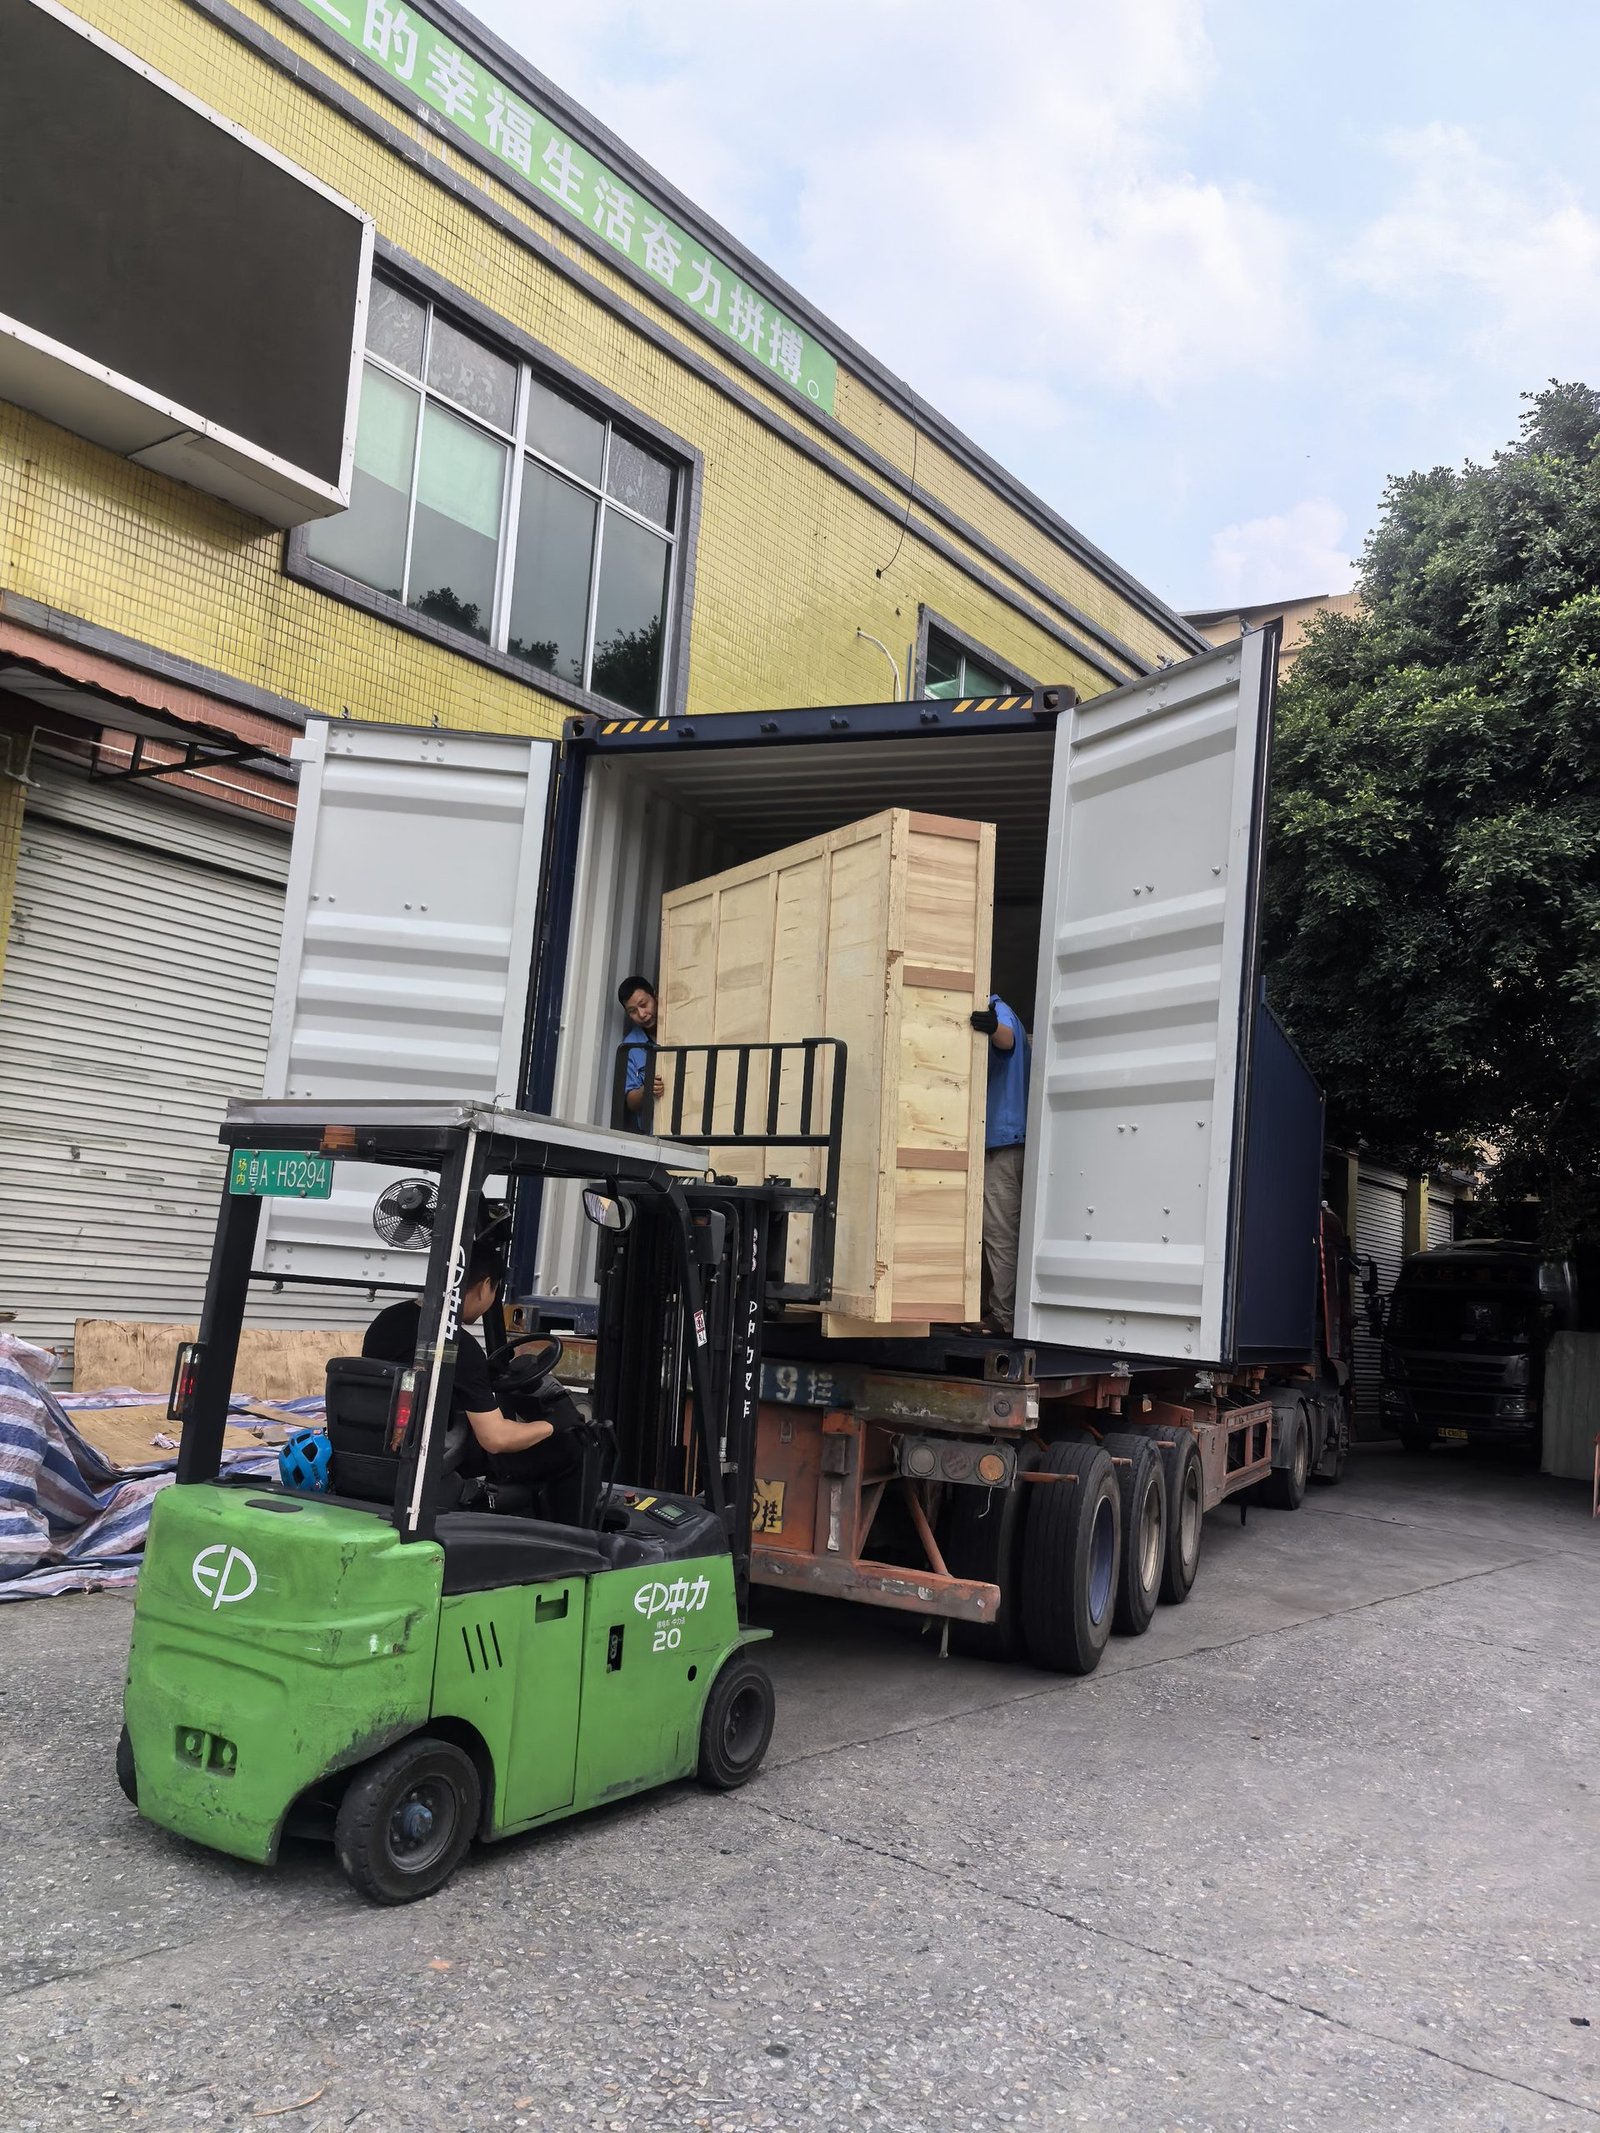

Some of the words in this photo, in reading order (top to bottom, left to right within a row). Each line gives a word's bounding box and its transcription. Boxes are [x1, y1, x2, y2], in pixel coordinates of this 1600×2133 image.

[236, 1158, 248, 1186] 场内
[192, 1544, 258, 1611] EP
[652, 1627, 682, 1653] 20
